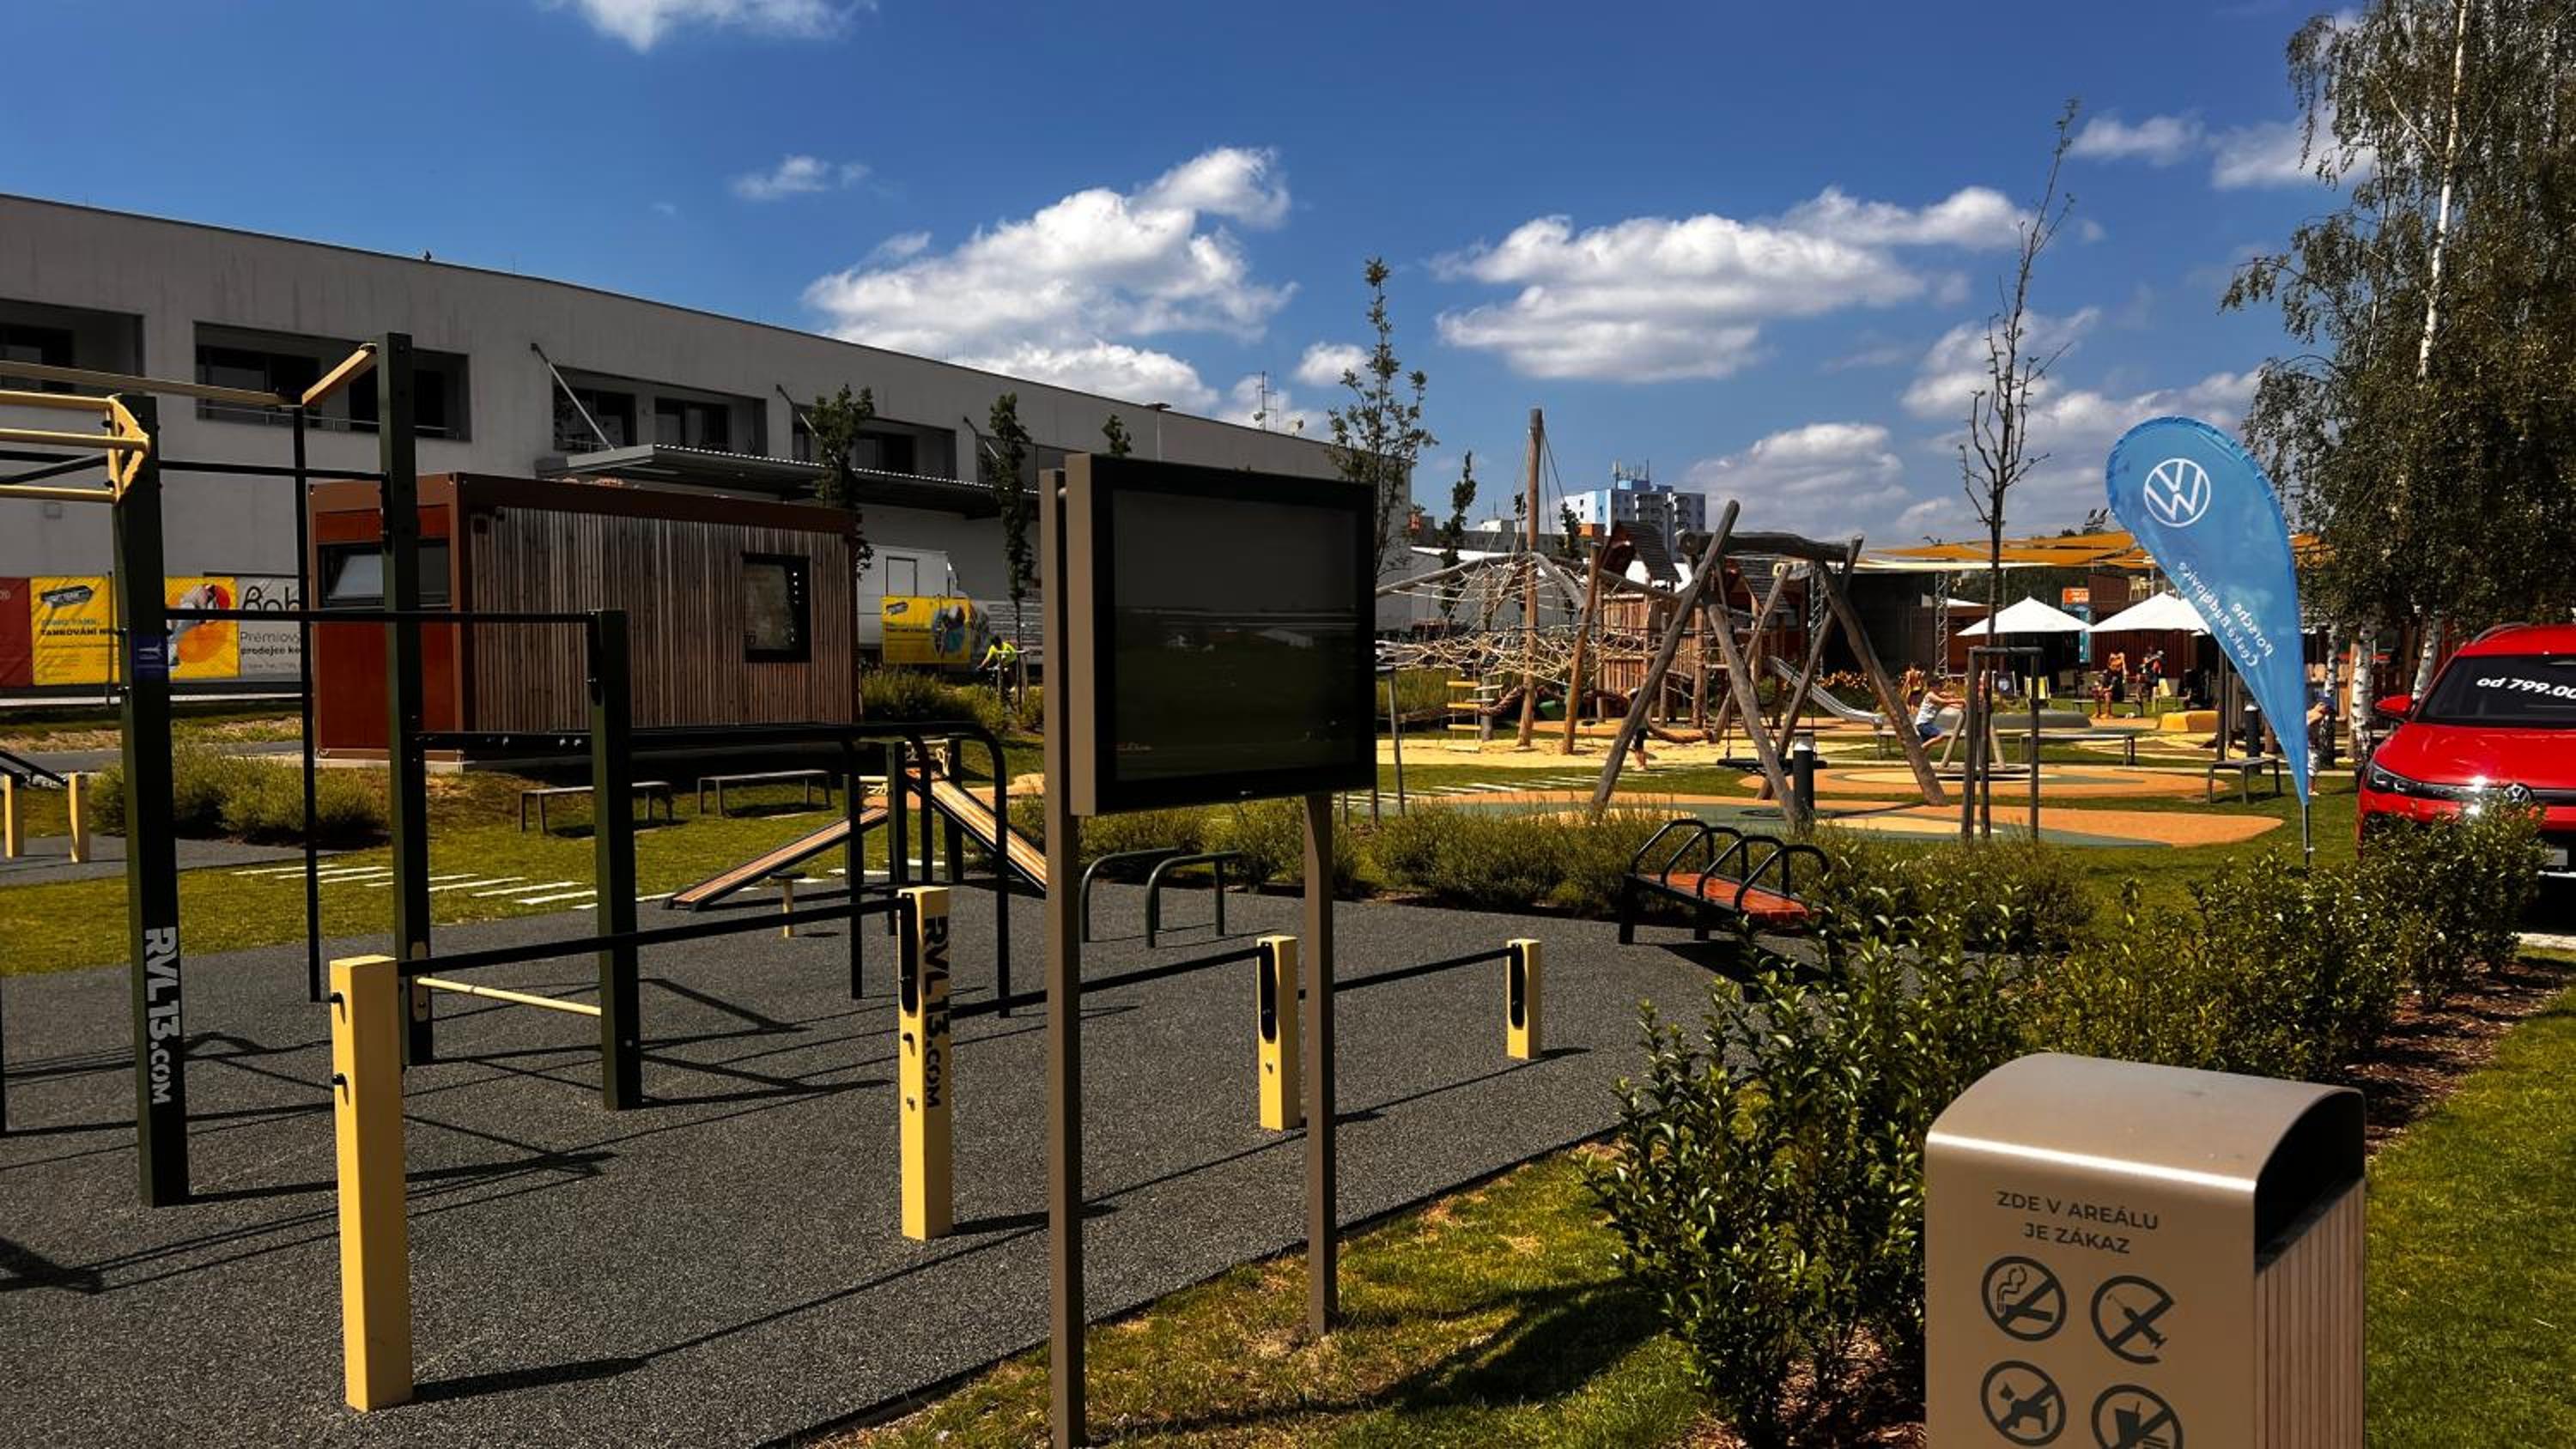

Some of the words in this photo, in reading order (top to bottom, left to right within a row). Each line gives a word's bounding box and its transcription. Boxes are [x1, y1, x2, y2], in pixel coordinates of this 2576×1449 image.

[243, 585, 301, 611] Bob
[2476, 677, 2506, 688] od
[145, 926, 181, 1105] RVL13.COM
[924, 916, 950, 1109] RVL13.COM
[1996, 1191, 2041, 1211] ZDE
[2047, 1198, 2062, 1215] V
[2068, 1202, 2159, 1230] AREÁLU
[2024, 1222, 2049, 1240] JE
[2056, 1227, 2130, 1254] ZÁKAZ
